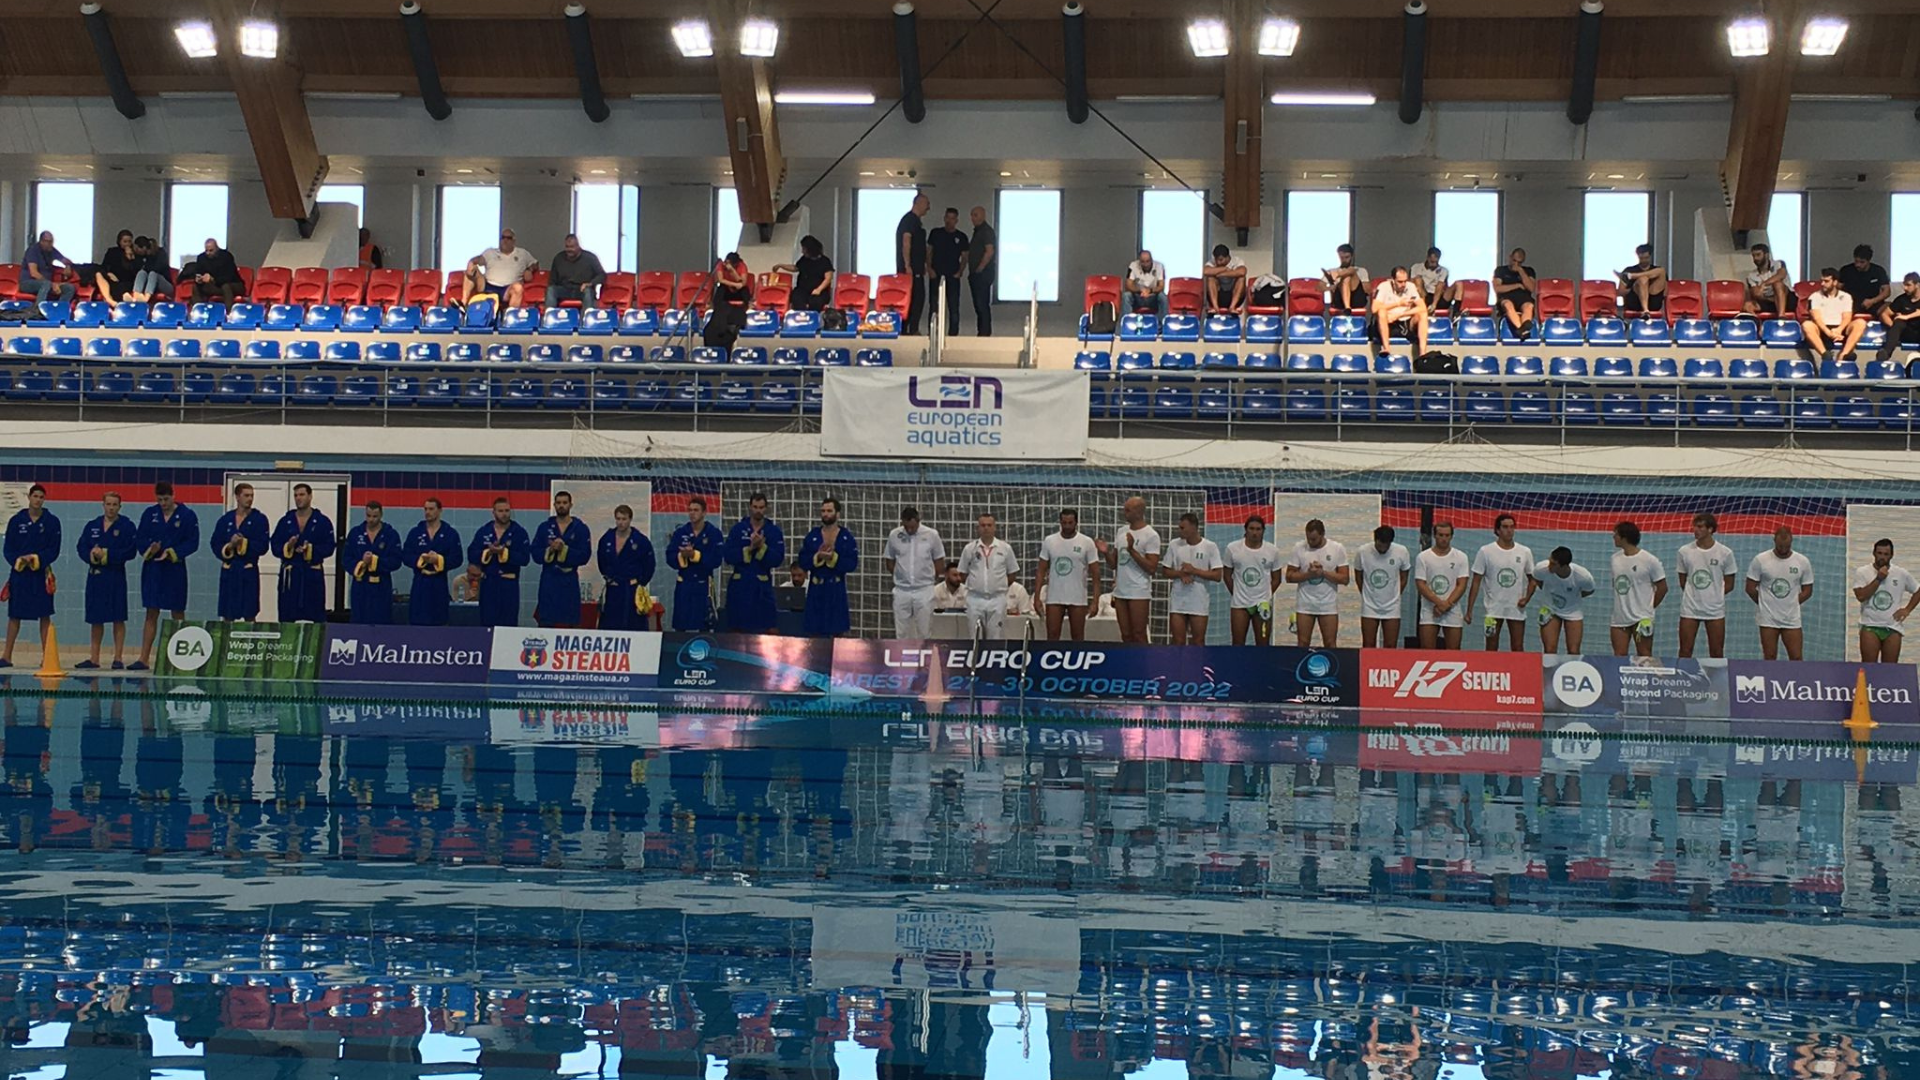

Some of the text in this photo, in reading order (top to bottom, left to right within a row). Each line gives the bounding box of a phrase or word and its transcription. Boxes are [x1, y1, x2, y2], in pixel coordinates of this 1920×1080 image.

[907, 375, 1003, 410] LEN
[907, 412, 1003, 429] european
[907, 427, 1002, 447] aquatics
[1788, 566, 1799, 574] 10
[174, 640, 206, 657] BA
[229, 640, 293, 651] Wrap Dreams
[554, 635, 632, 654] MAGAZIN
[227, 651, 315, 664] Beyond Packaging
[360, 644, 484, 666] Malmsten
[552, 651, 631, 672] STEAUA
[946, 650, 1032, 669] EURO
[1040, 651, 1106, 671] CUP
[517, 672, 630, 684] www.magazinsteaua.ro
[673, 678, 717, 687] EURO CUP
[1368, 668, 1400, 688] KAP
[1462, 671, 1511, 692] SEVEN
[1561, 675, 1596, 693] BA
[1619, 675, 1692, 688] Wrap Dreams
[1040, 677, 1160, 696] OCTOBER
[1165, 681, 1232, 698] 2022
[1620, 688, 1719, 701] Beyond Packaging
[1770, 679, 1912, 704] Malmten
[1320, 695, 1341, 703] CUP
[1496, 694, 1536, 705] kap7.com
